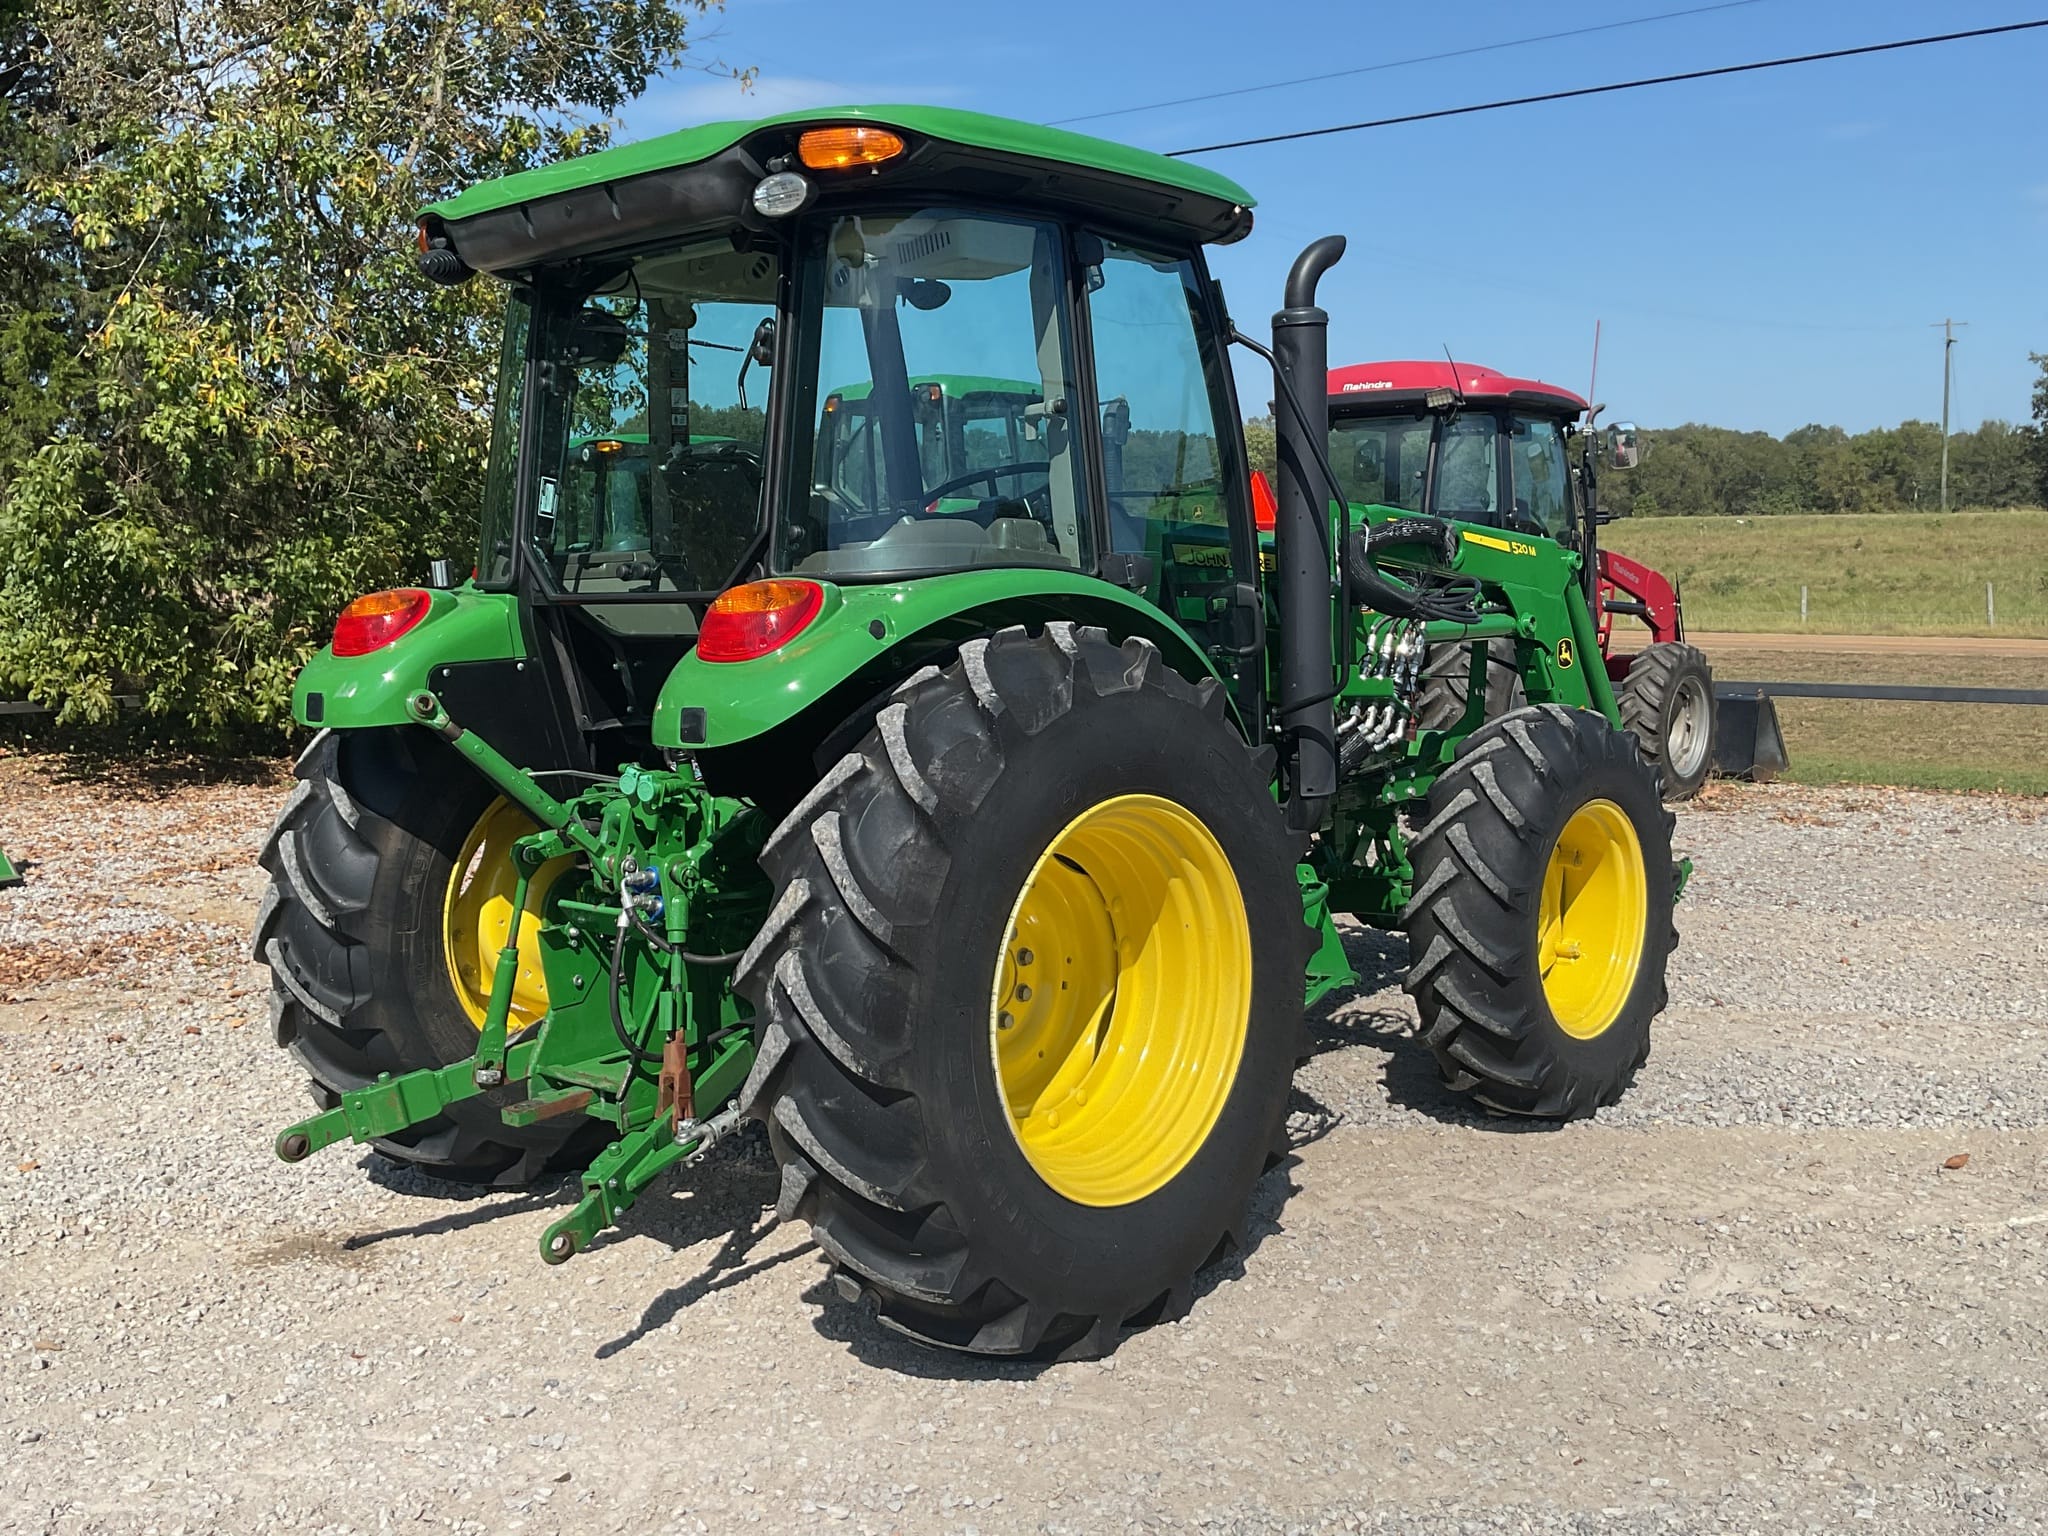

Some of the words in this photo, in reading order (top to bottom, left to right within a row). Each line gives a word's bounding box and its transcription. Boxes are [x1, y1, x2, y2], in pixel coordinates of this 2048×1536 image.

[1343, 380, 1393, 391] Mahindra
[1188, 548, 1227, 566] JOHN
[1511, 541, 1528, 555] 520
[1528, 545, 1537, 557] M
